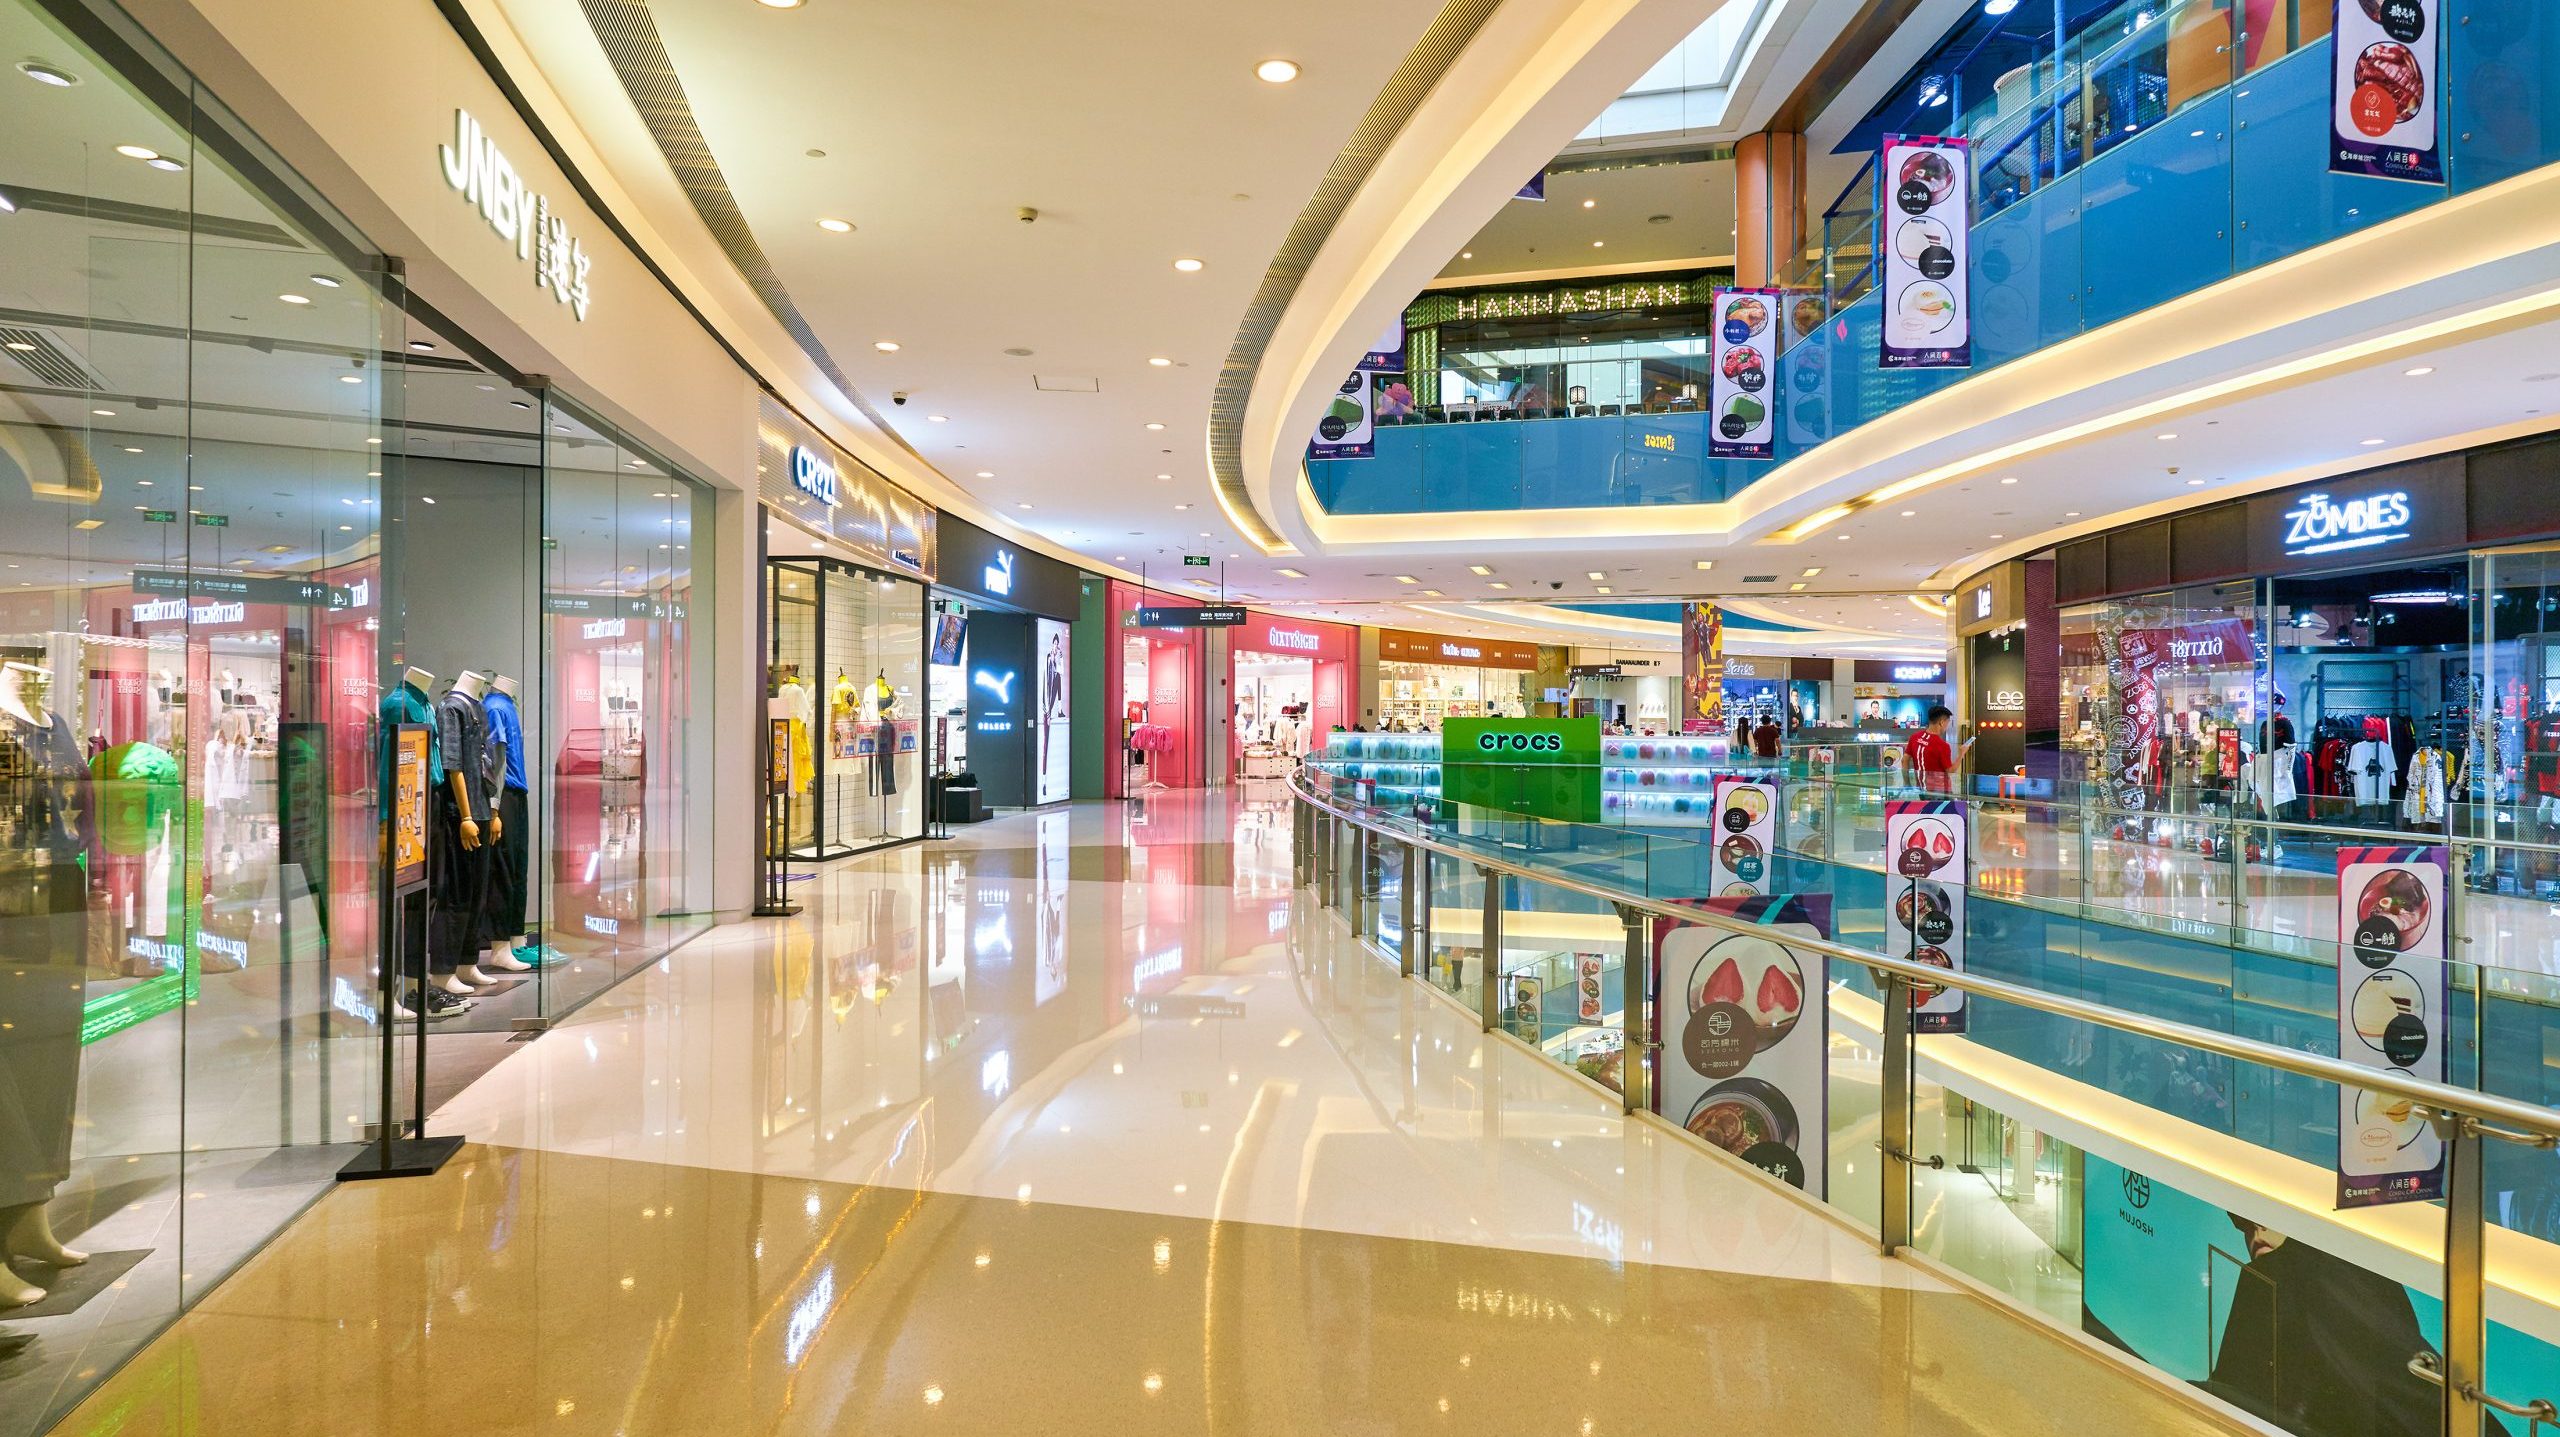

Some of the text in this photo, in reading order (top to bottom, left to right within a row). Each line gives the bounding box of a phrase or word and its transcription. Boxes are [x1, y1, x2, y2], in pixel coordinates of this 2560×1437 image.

[438, 108, 536, 260] JNBY
[1458, 284, 1680, 319] HANNASHAN
[2285, 492, 2410, 543] ZOMBIES
[1125, 614, 1137, 626] L4
[1269, 626, 1320, 650] 6IXTY8IGHT
[1987, 690, 2024, 705] Lee
[977, 721, 1012, 731] SELECT
[1479, 733, 1561, 751] crocs
[2119, 1208, 2154, 1238] MUJOSH
